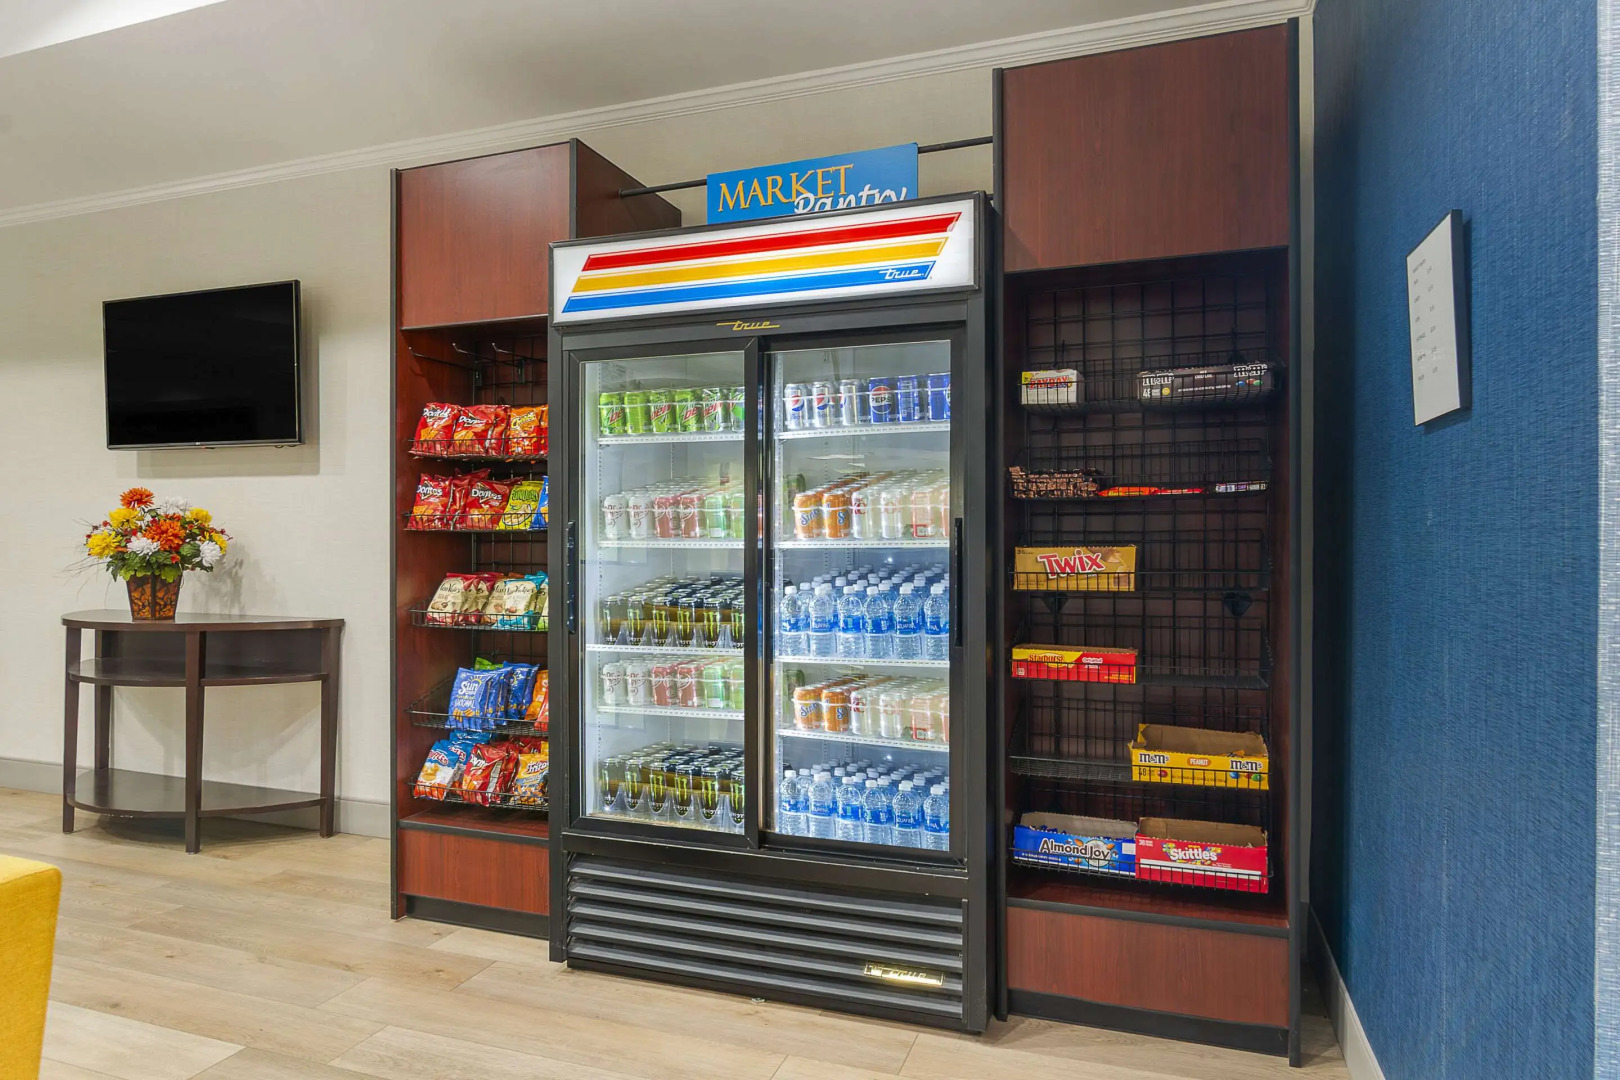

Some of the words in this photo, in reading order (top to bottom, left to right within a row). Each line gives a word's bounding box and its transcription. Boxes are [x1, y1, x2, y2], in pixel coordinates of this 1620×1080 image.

[718, 163, 855, 213] MARKET
[879, 268, 925, 279] true
[716, 320, 781, 331] true
[472, 488, 502, 502] Doritos
[1038, 549, 1105, 579] Twix
[1189, 758, 1209, 766] PEANUT
[1039, 837, 1088, 855] Almond
[1089, 845, 1112, 859] Joy
[1170, 847, 1218, 861] Skittles
